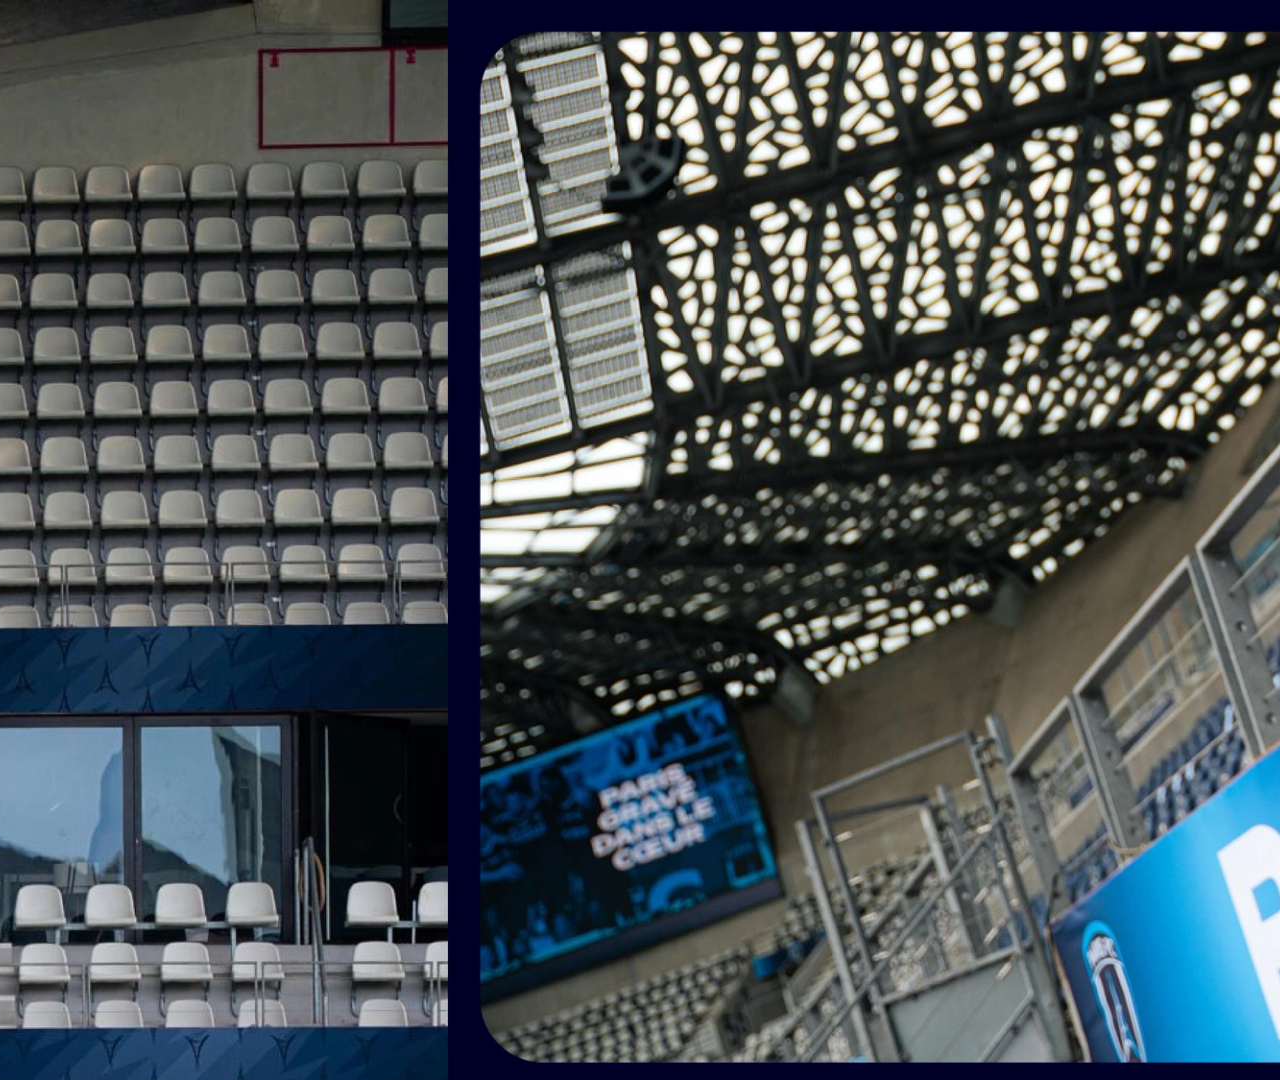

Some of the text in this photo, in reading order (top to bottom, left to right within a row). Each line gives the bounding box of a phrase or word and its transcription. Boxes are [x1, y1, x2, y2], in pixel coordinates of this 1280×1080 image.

[598, 762, 687, 811] PARIS
[590, 796, 716, 858] DANS LE
